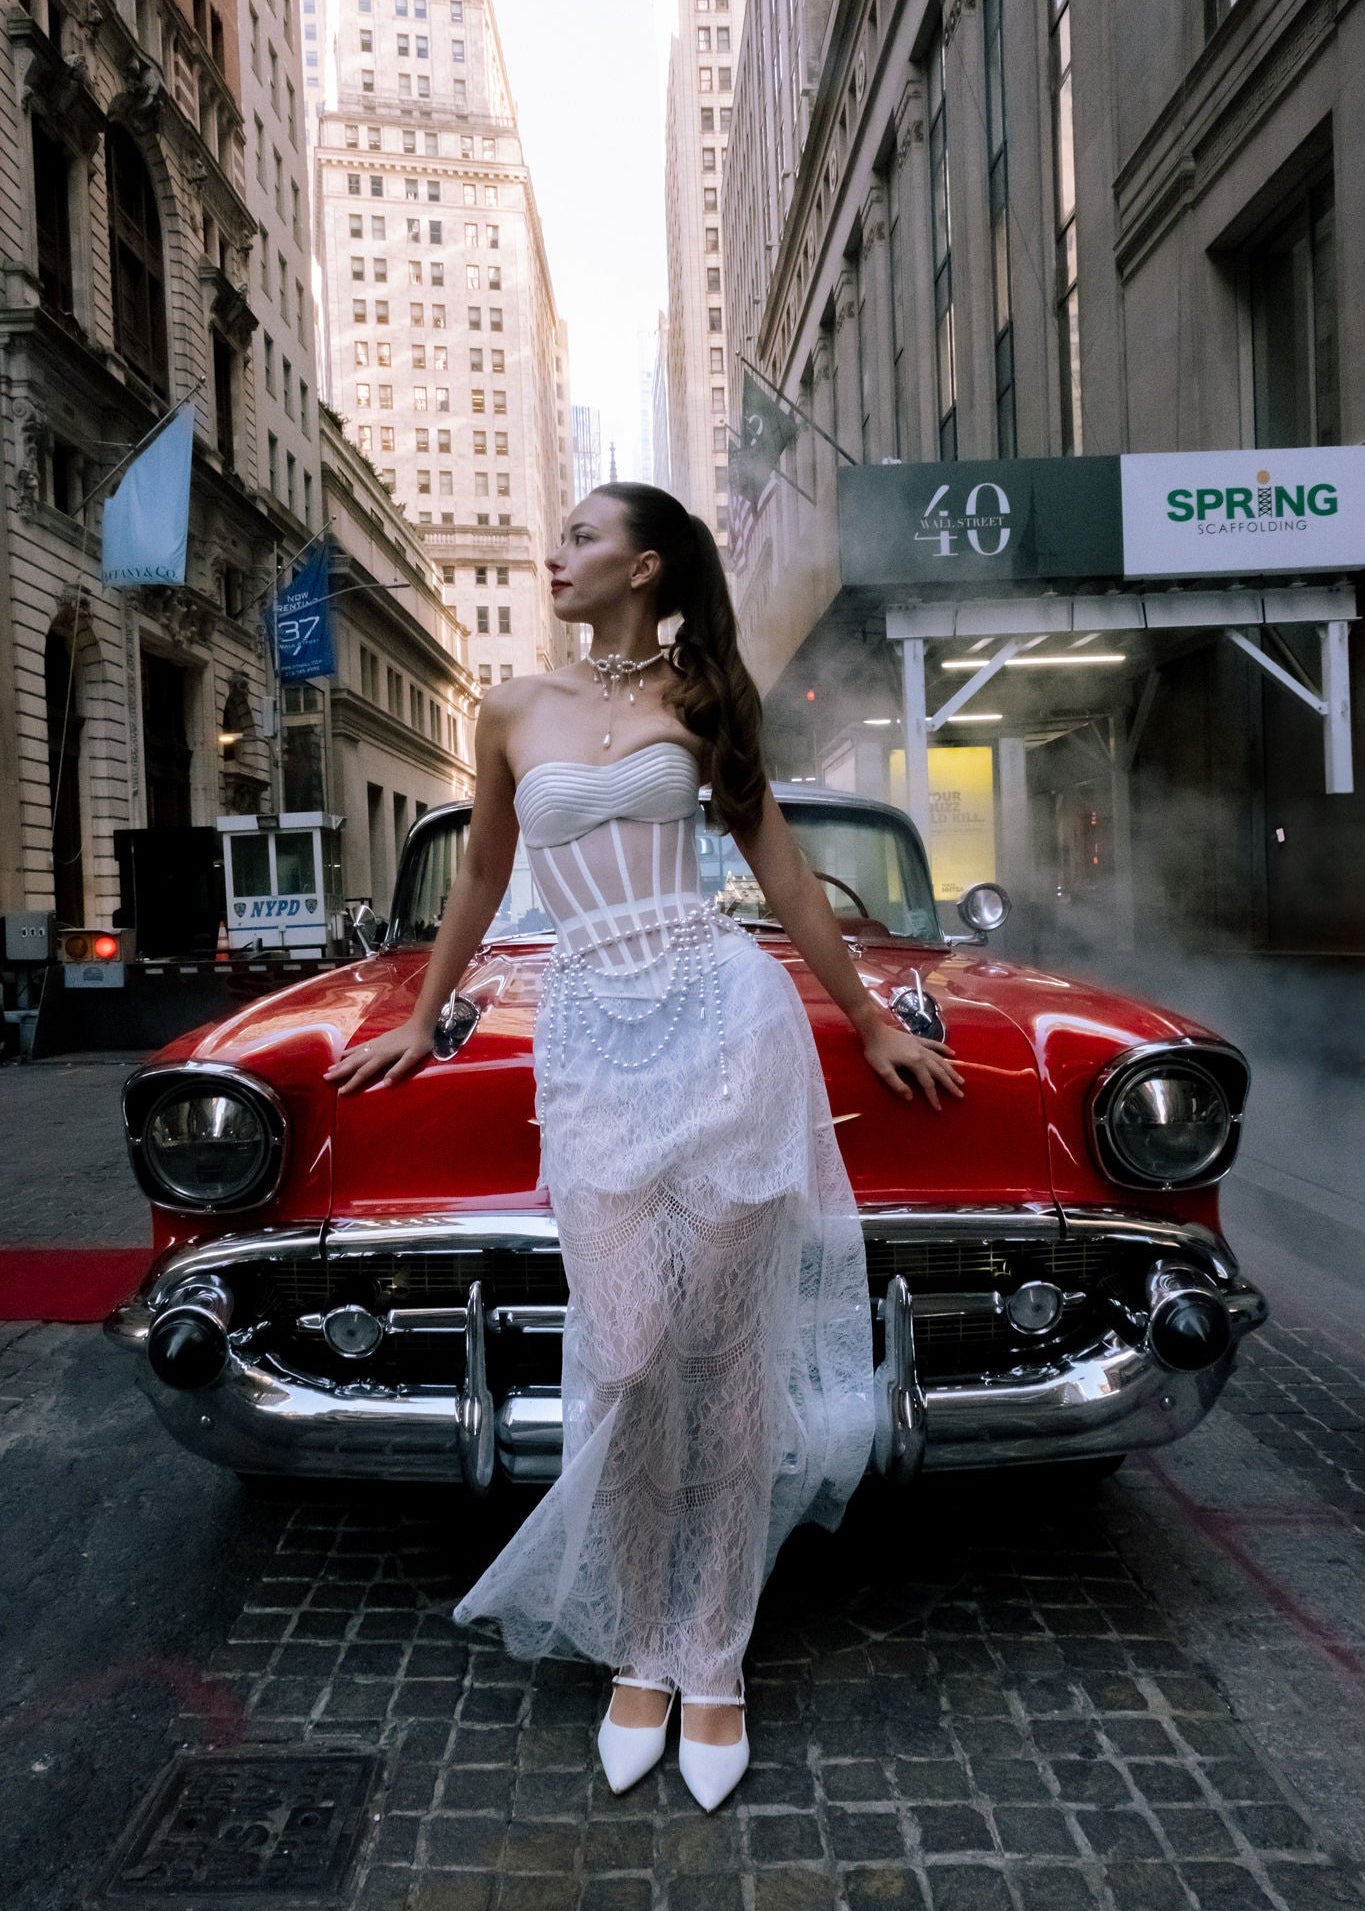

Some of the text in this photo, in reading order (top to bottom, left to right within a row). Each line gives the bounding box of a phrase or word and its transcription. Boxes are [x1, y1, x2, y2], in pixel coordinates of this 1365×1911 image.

[1167, 470, 1338, 522] SPRING
[914, 483, 1011, 556] 40
[921, 516, 1005, 529] WALL STREET
[1197, 520, 1308, 535] SCAFFOLDING
[287, 591, 309, 602] NOW
[278, 615, 320, 656] 37
[250, 899, 301, 918] NYPD
